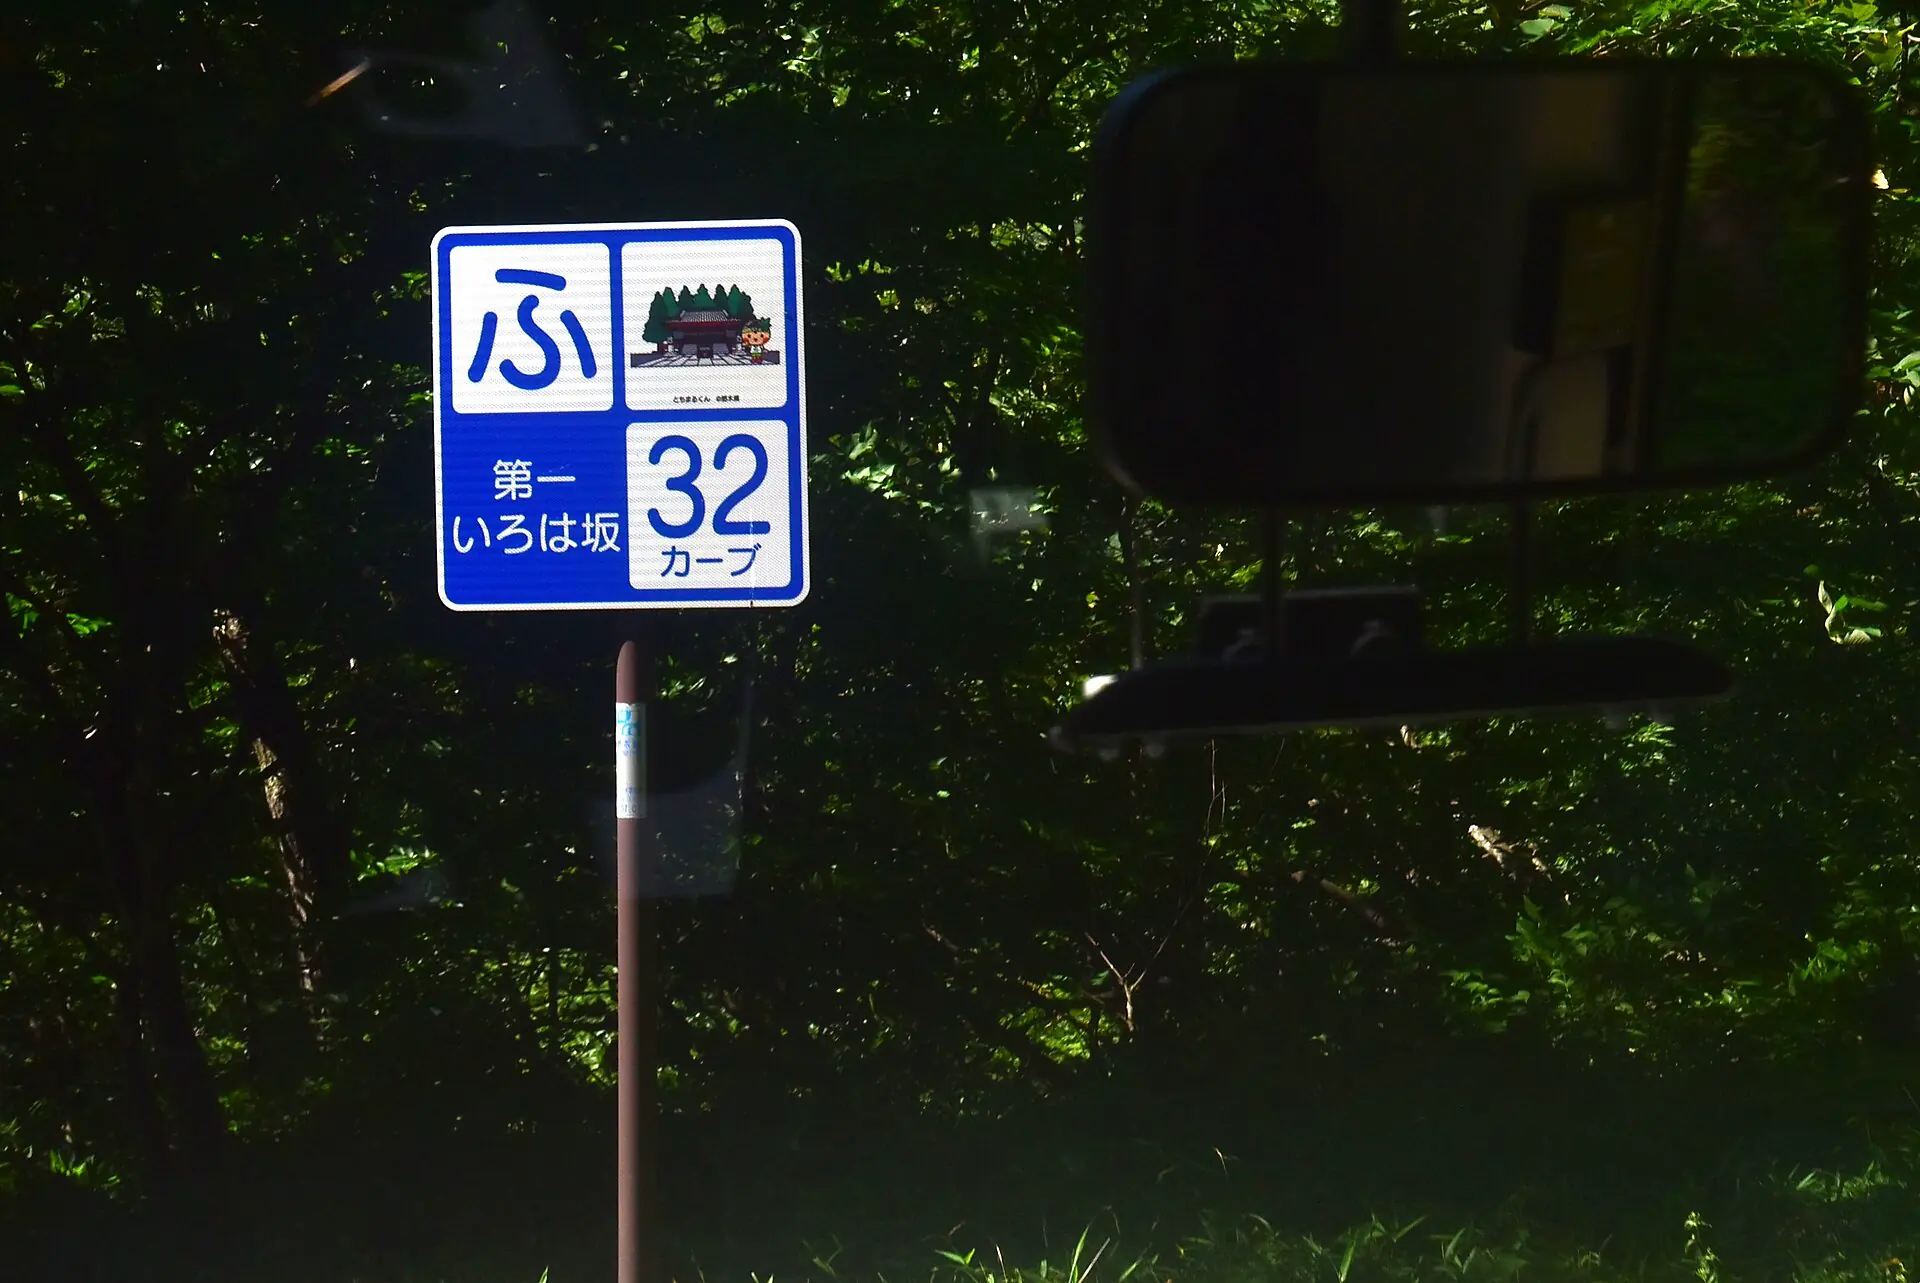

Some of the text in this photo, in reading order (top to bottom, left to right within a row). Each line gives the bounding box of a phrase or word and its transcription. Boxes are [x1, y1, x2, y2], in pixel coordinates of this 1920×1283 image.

[468, 268, 597, 391] ふ
[493, 458, 576, 501] 第一
[647, 433, 771, 539] 32
[452, 512, 621, 554] いろは坂
[660, 542, 762, 577] カーブ
